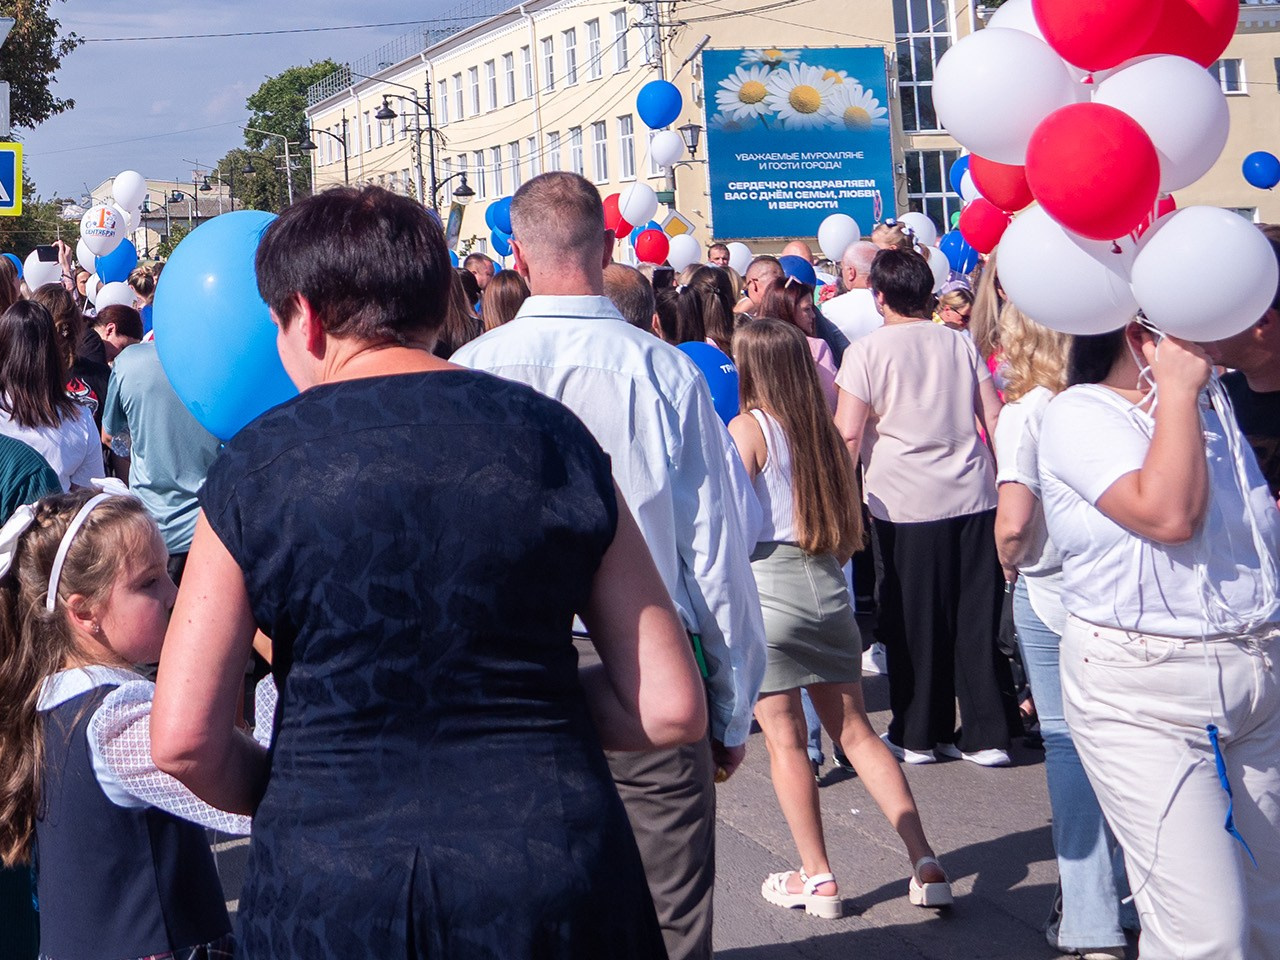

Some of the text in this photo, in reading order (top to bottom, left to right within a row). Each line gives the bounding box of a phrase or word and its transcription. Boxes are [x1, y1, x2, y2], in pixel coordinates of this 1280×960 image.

[735, 151, 864, 161] УВАЖАЕМЫЕ МУРОМЛЯНЕ
[759, 161, 842, 170] И ГОСТИ ГОРОДА!
[728, 179, 875, 190] СЕРДЕЧНО ПОЗДРАВЛЯЕМ
[724, 189, 880, 200] ВАС С ДНЁМ СЕМЬИ, ЛЮБВИ
[768, 200, 839, 209] И ВЕРНОСТИ
[96, 208, 106, 228] 1
